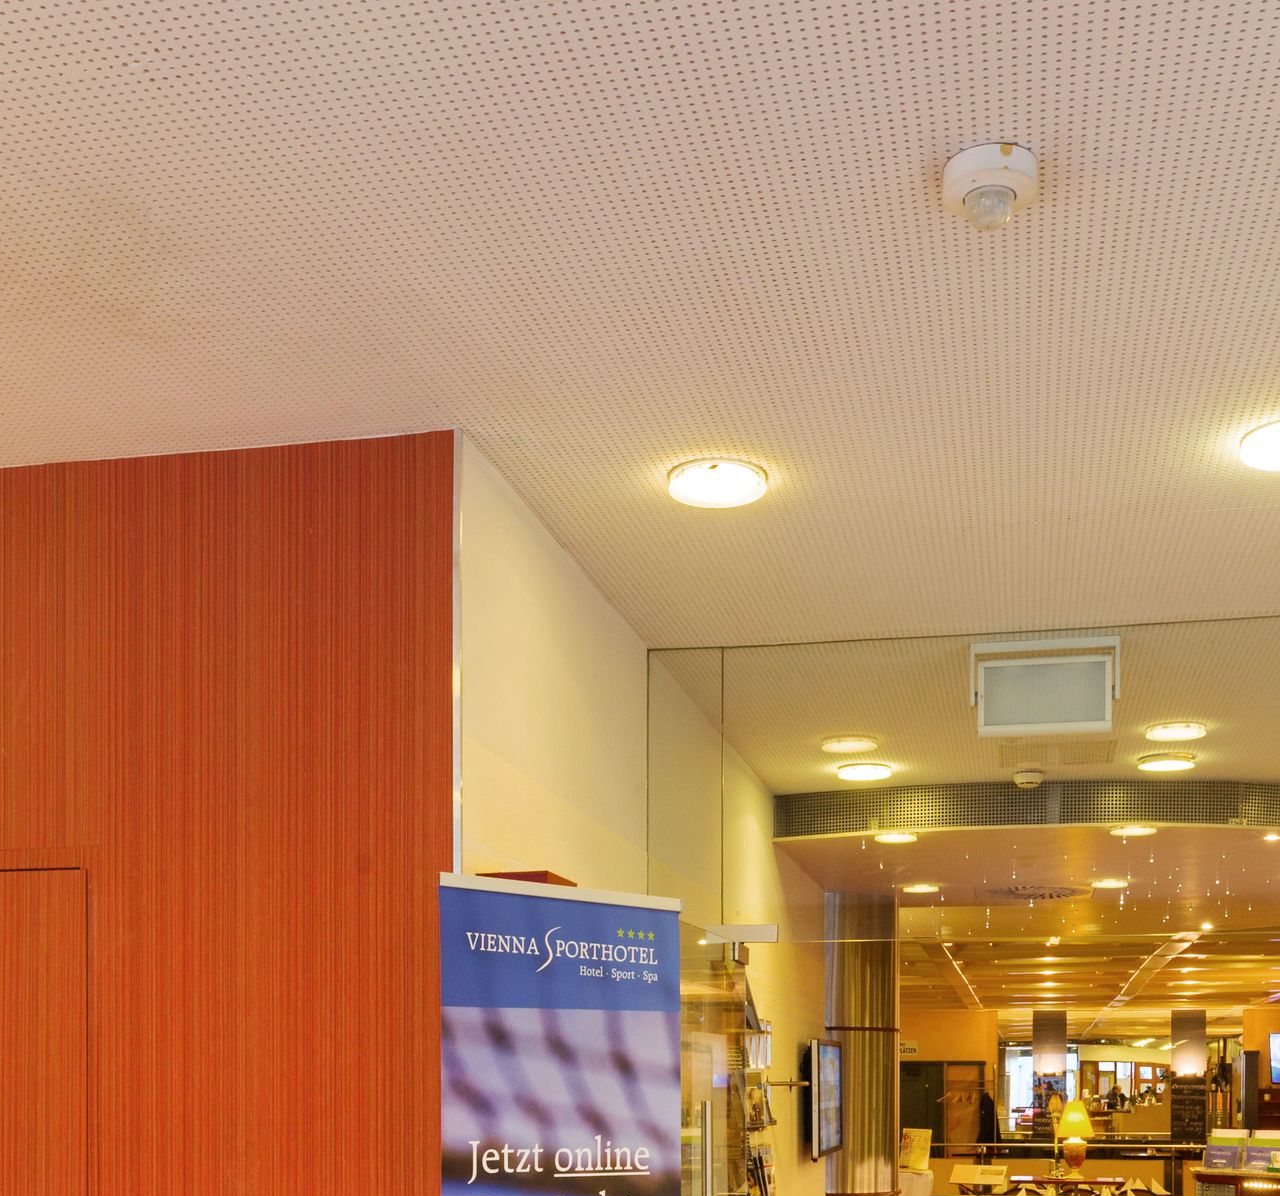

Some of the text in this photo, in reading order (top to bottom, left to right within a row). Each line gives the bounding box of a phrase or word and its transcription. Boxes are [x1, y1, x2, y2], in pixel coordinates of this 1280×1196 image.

[465, 926, 658, 973] VIENNA SPORTHOTEL
[579, 965, 658, 983] Hotel Sport Spa
[467, 1135, 650, 1184] Jetzt online
